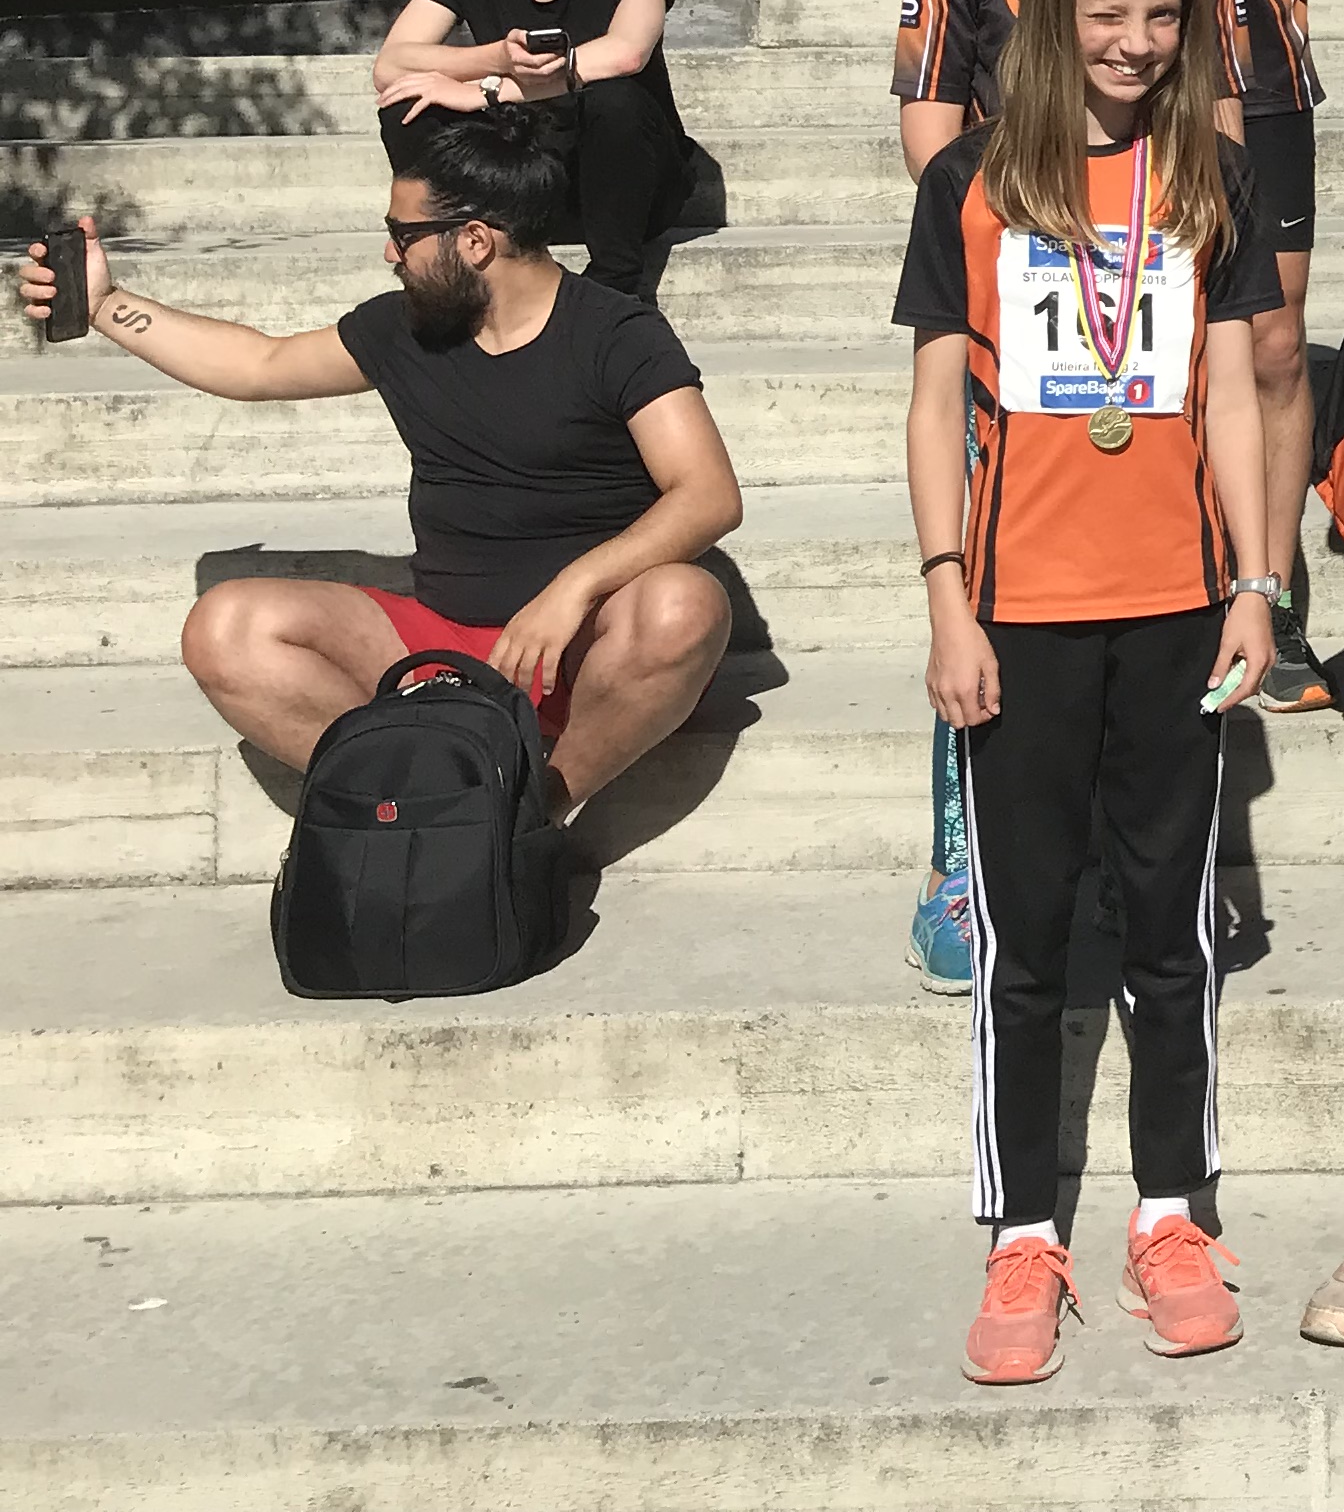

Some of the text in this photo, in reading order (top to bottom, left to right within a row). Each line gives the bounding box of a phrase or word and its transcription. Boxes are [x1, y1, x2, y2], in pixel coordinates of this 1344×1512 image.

[1022, 272, 1038, 282] ST
[1052, 361, 1090, 372] Utleira
[1045, 380, 1126, 397] SpareBak
